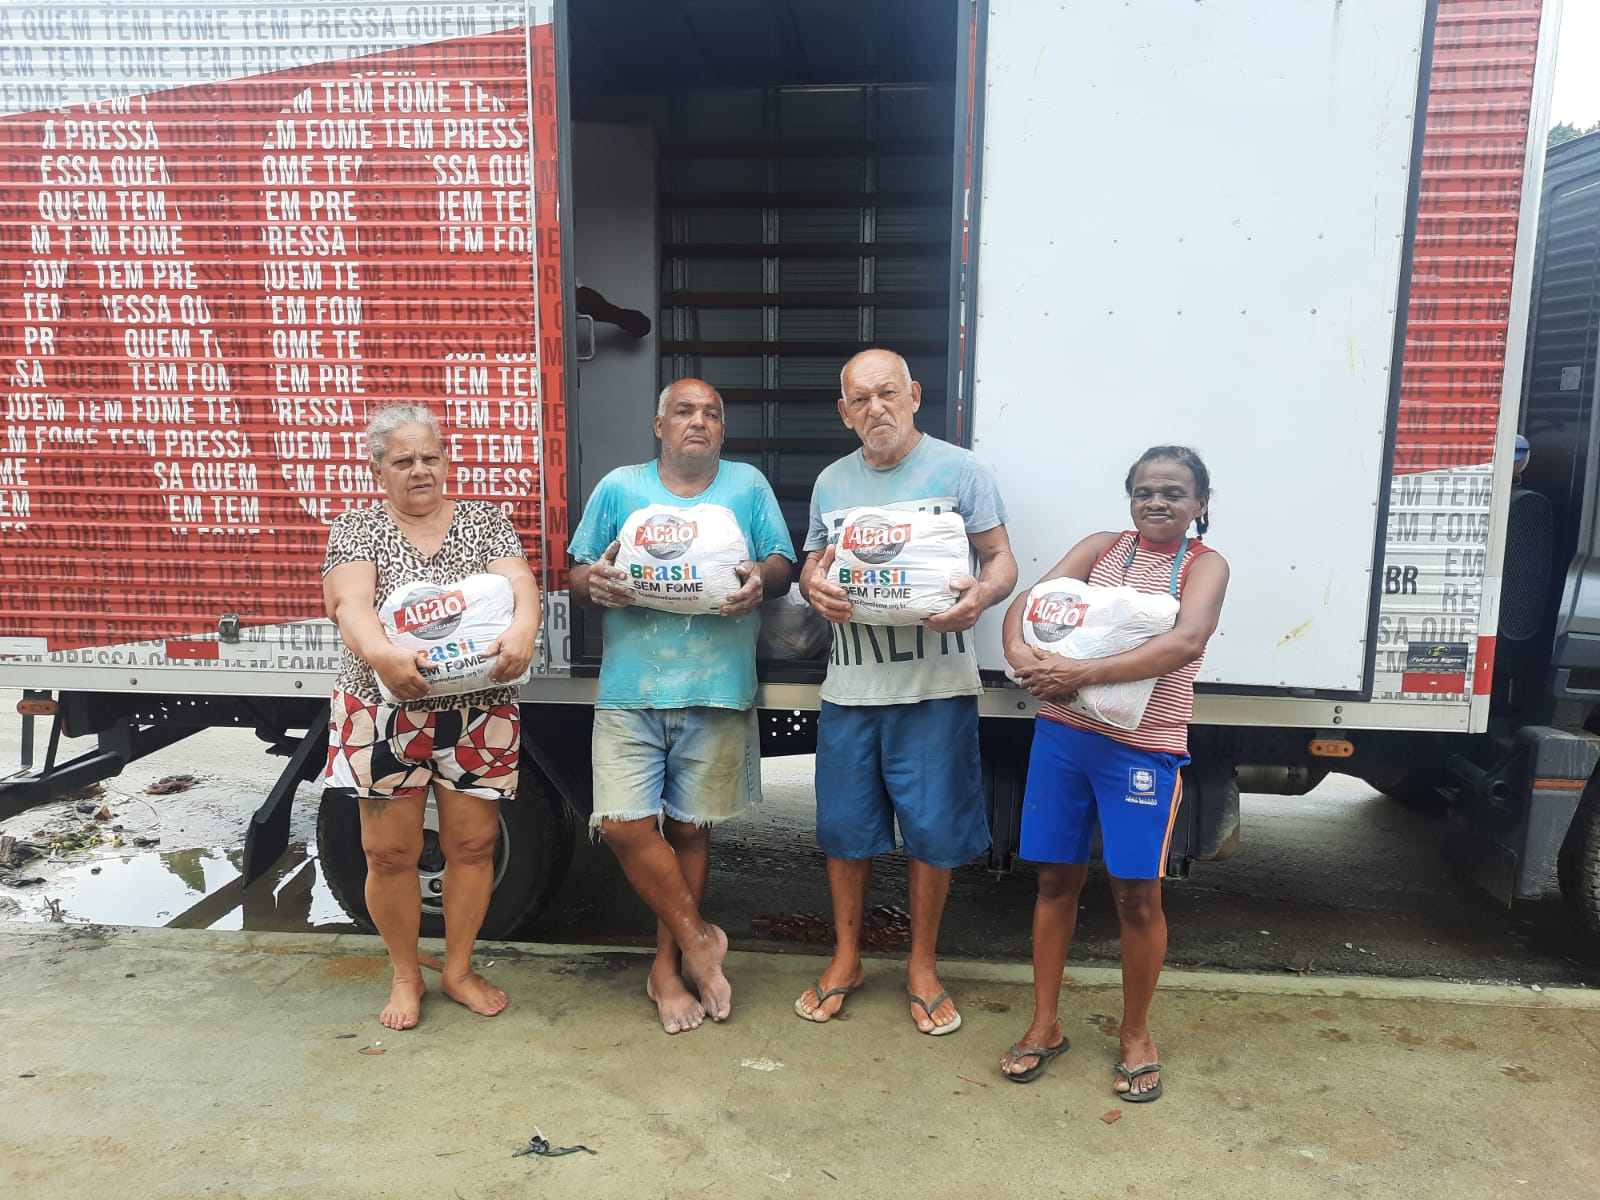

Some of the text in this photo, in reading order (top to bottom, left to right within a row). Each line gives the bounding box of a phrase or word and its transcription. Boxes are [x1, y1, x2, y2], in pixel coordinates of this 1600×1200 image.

[22, 10, 91, 41] QUEM
[101, 9, 152, 40] TEM
[162, 9, 229, 39] FOME
[239, 8, 290, 39] TEM
[301, 7, 396, 39] PRESSA
[407, 6, 476, 39] QUEM
[43, 48, 95, 77] TEM
[104, 47, 172, 77] FOME
[180, 47, 232, 76] TEM
[242, 46, 338, 76] PRESSA
[321, 82, 373, 112] TEM
[383, 81, 451, 112] FOME
[64, 120, 159, 150] PRESSA
[306, 119, 373, 149] FOME
[382, 119, 433, 149] TEM
[38, 190, 108, 222] QUEM
[116, 190, 167, 221] TEM
[119, 226, 184, 255] FOME
[94, 261, 143, 289] TEM
[124, 329, 191, 359] QUEM
[128, 363, 178, 391] TEM
[131, 396, 195, 424] FOME
[473, 435, 522, 463] TEM
[192, 462, 258, 491] QUEM
[210, 496, 259, 523] TEM
[633, 580, 703, 592] SEM FOME
[874, 588, 911, 598] FOME
[1385, 565, 1419, 595] BR
[275, 625, 323, 651] TEM
